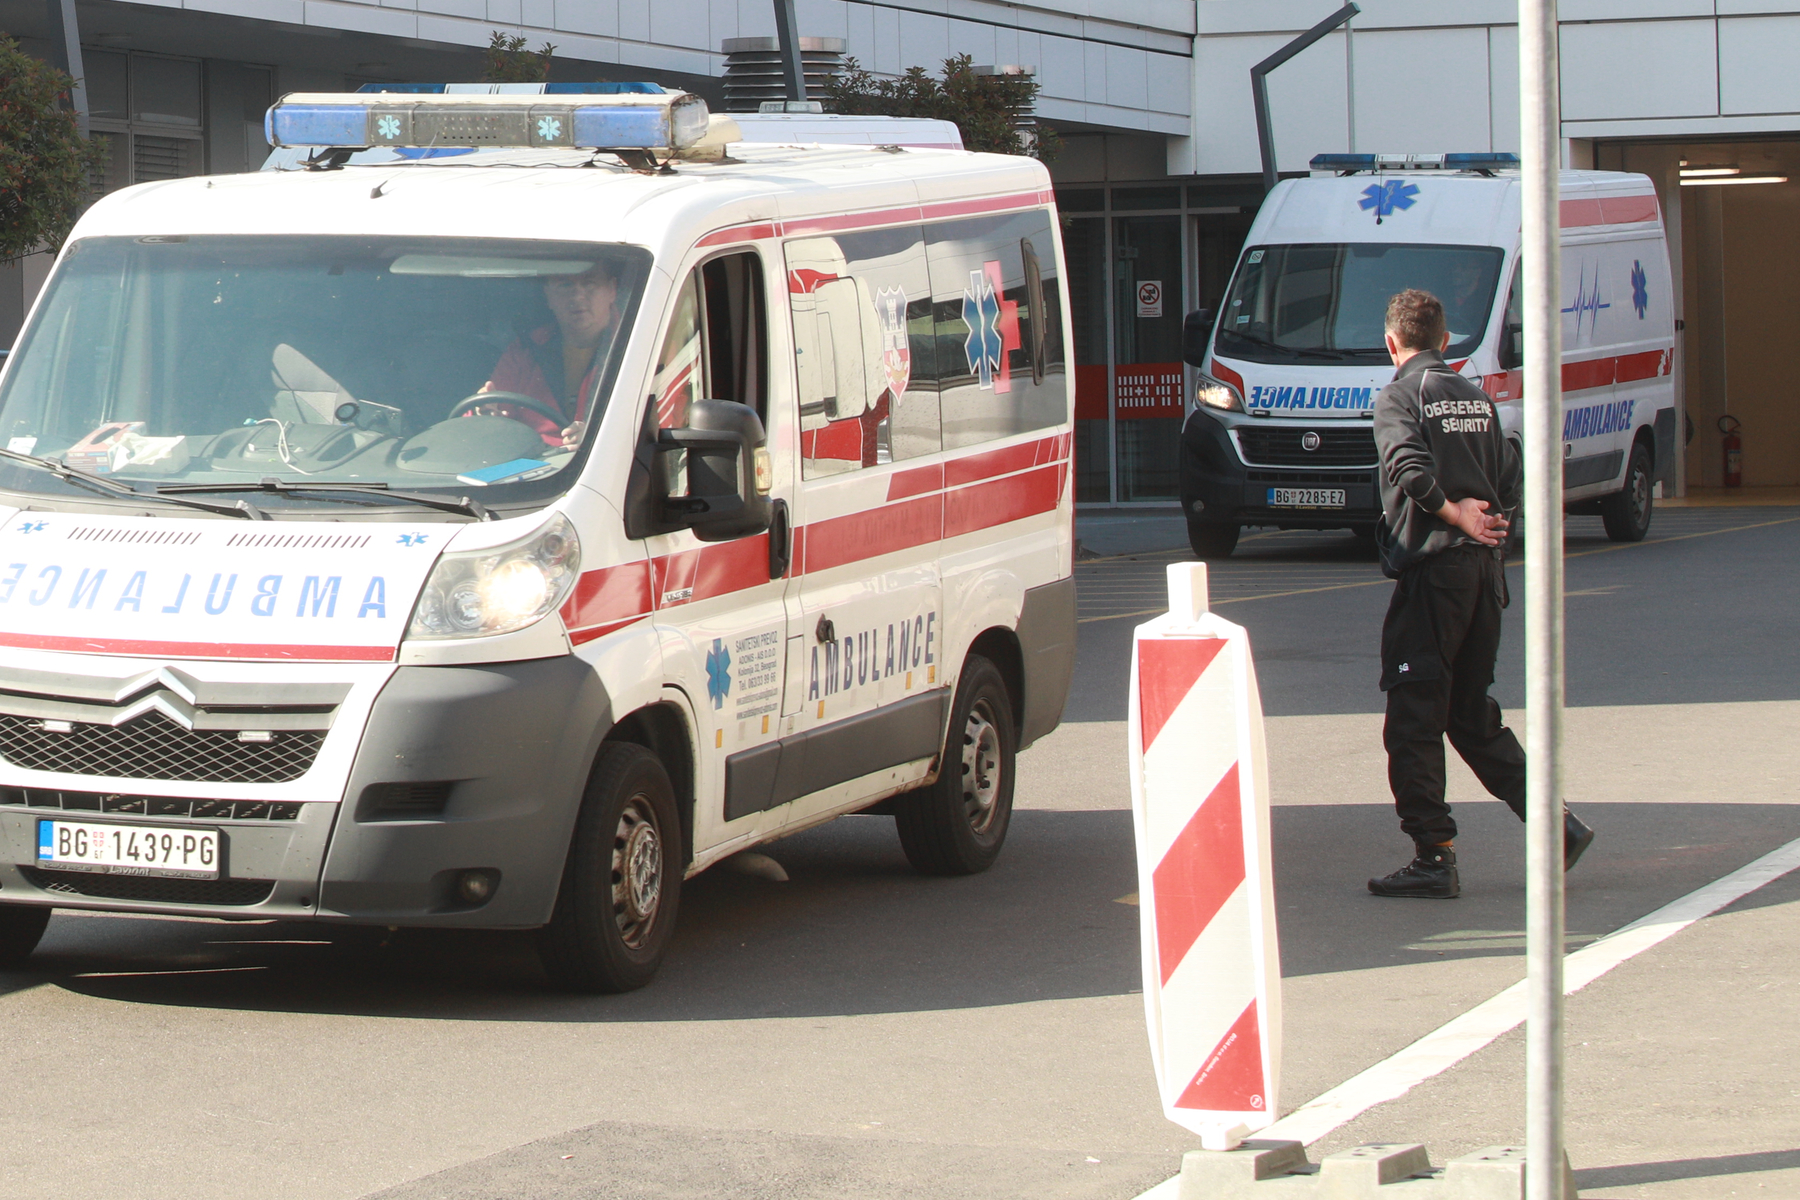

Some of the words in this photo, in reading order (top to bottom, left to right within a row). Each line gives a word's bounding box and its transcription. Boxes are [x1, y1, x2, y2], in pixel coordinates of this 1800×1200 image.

[1562, 400, 1635, 441] AMBULANCE
[1276, 490, 1289, 503] BG
[808, 611, 935, 701] AMBULANCE
[59, 827, 88, 857] BG
